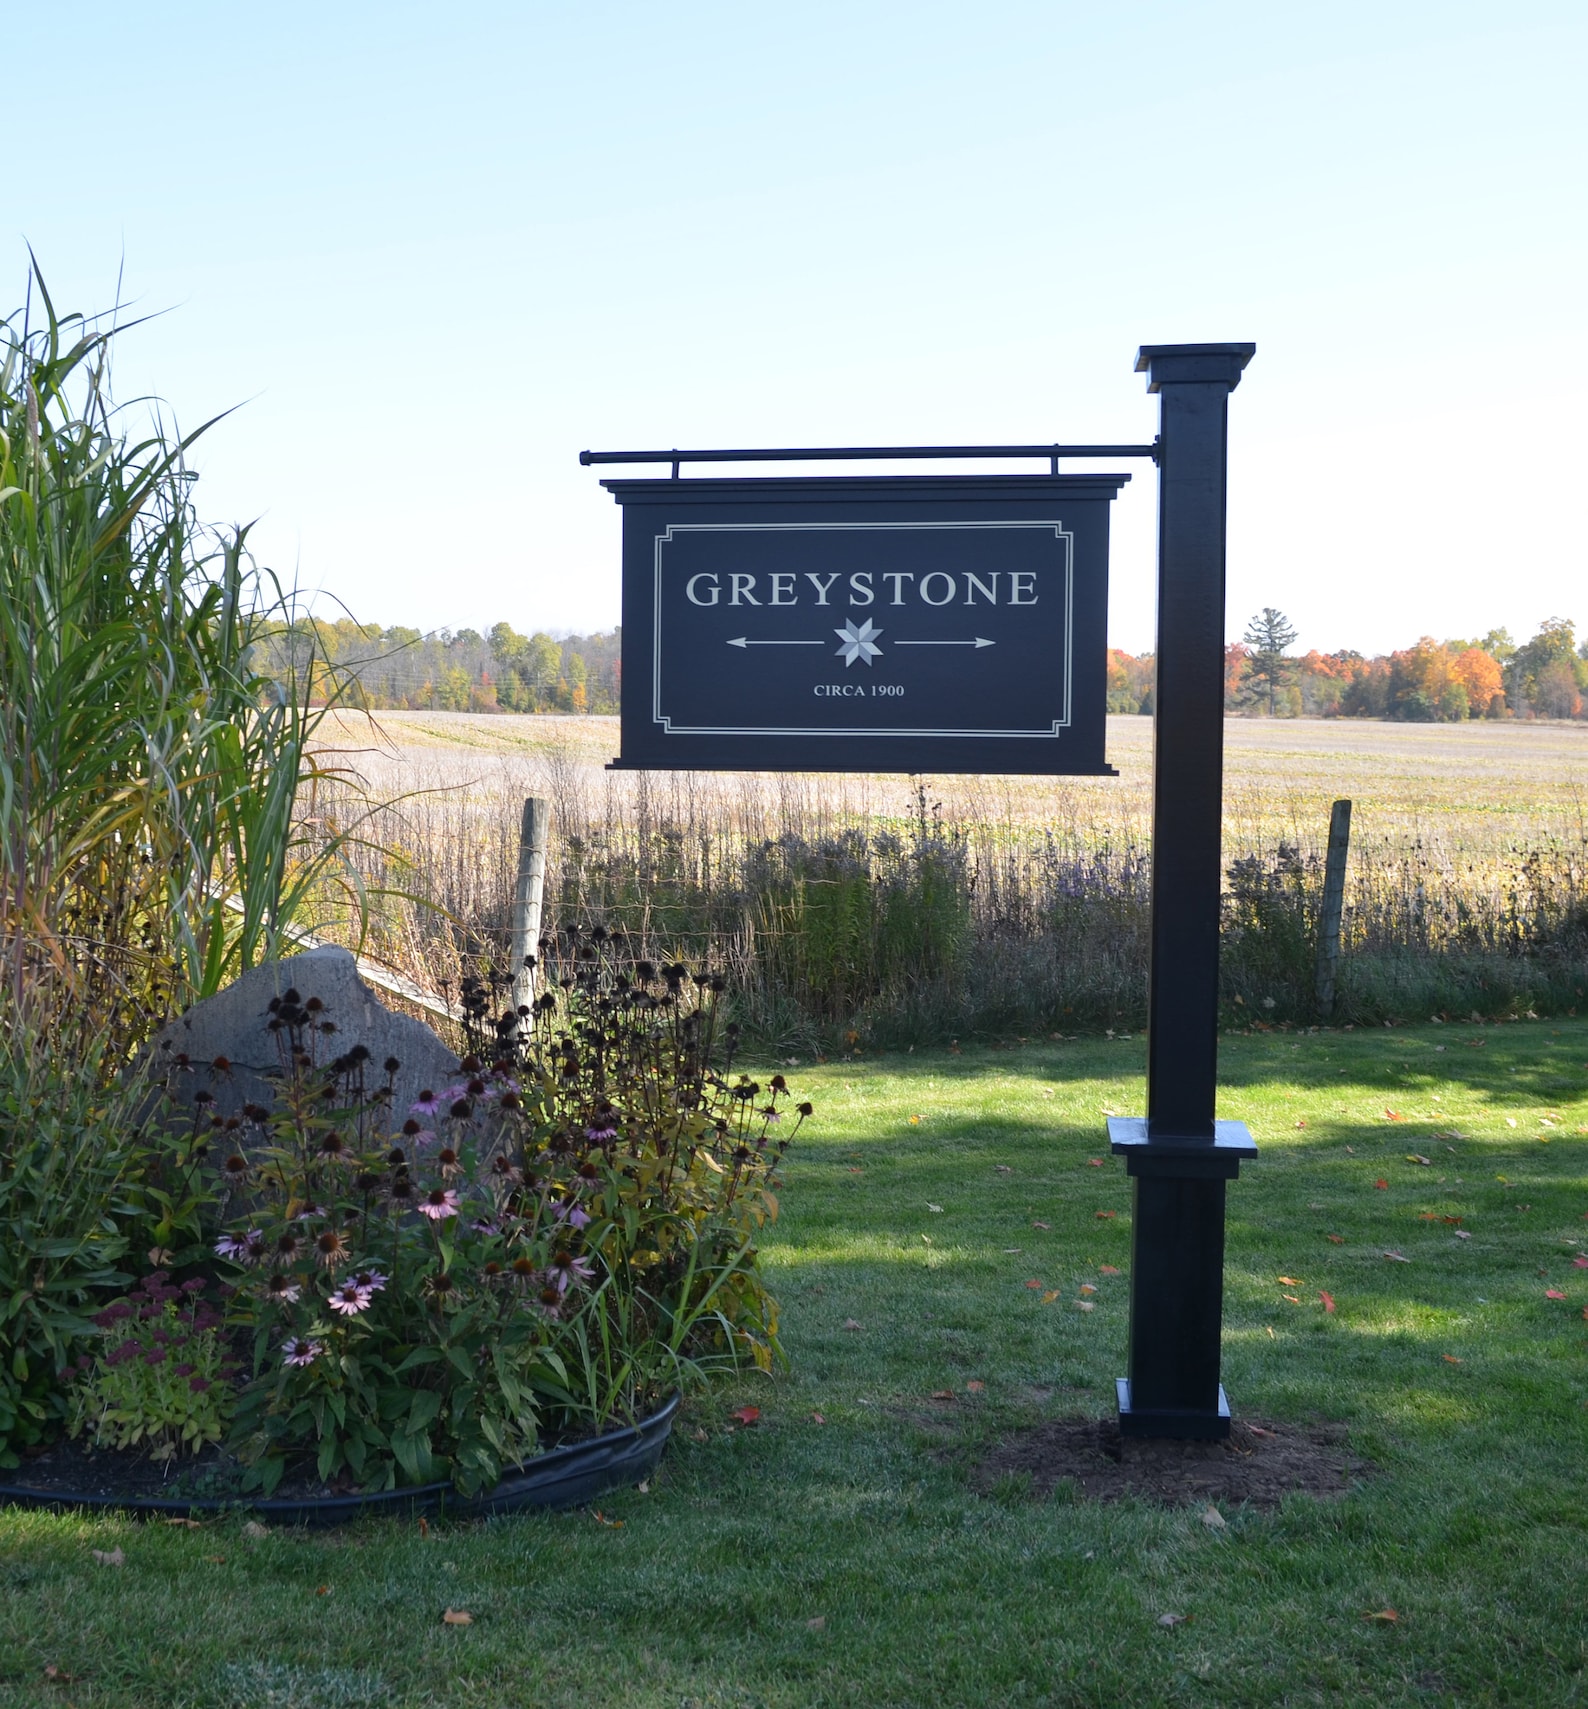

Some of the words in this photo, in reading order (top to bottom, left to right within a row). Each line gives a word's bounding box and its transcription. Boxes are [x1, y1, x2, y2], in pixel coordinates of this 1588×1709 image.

[685, 571, 1039, 607] GREYSTONE
[813, 684, 866, 697] CIRCA
[871, 684, 905, 697] 1900
